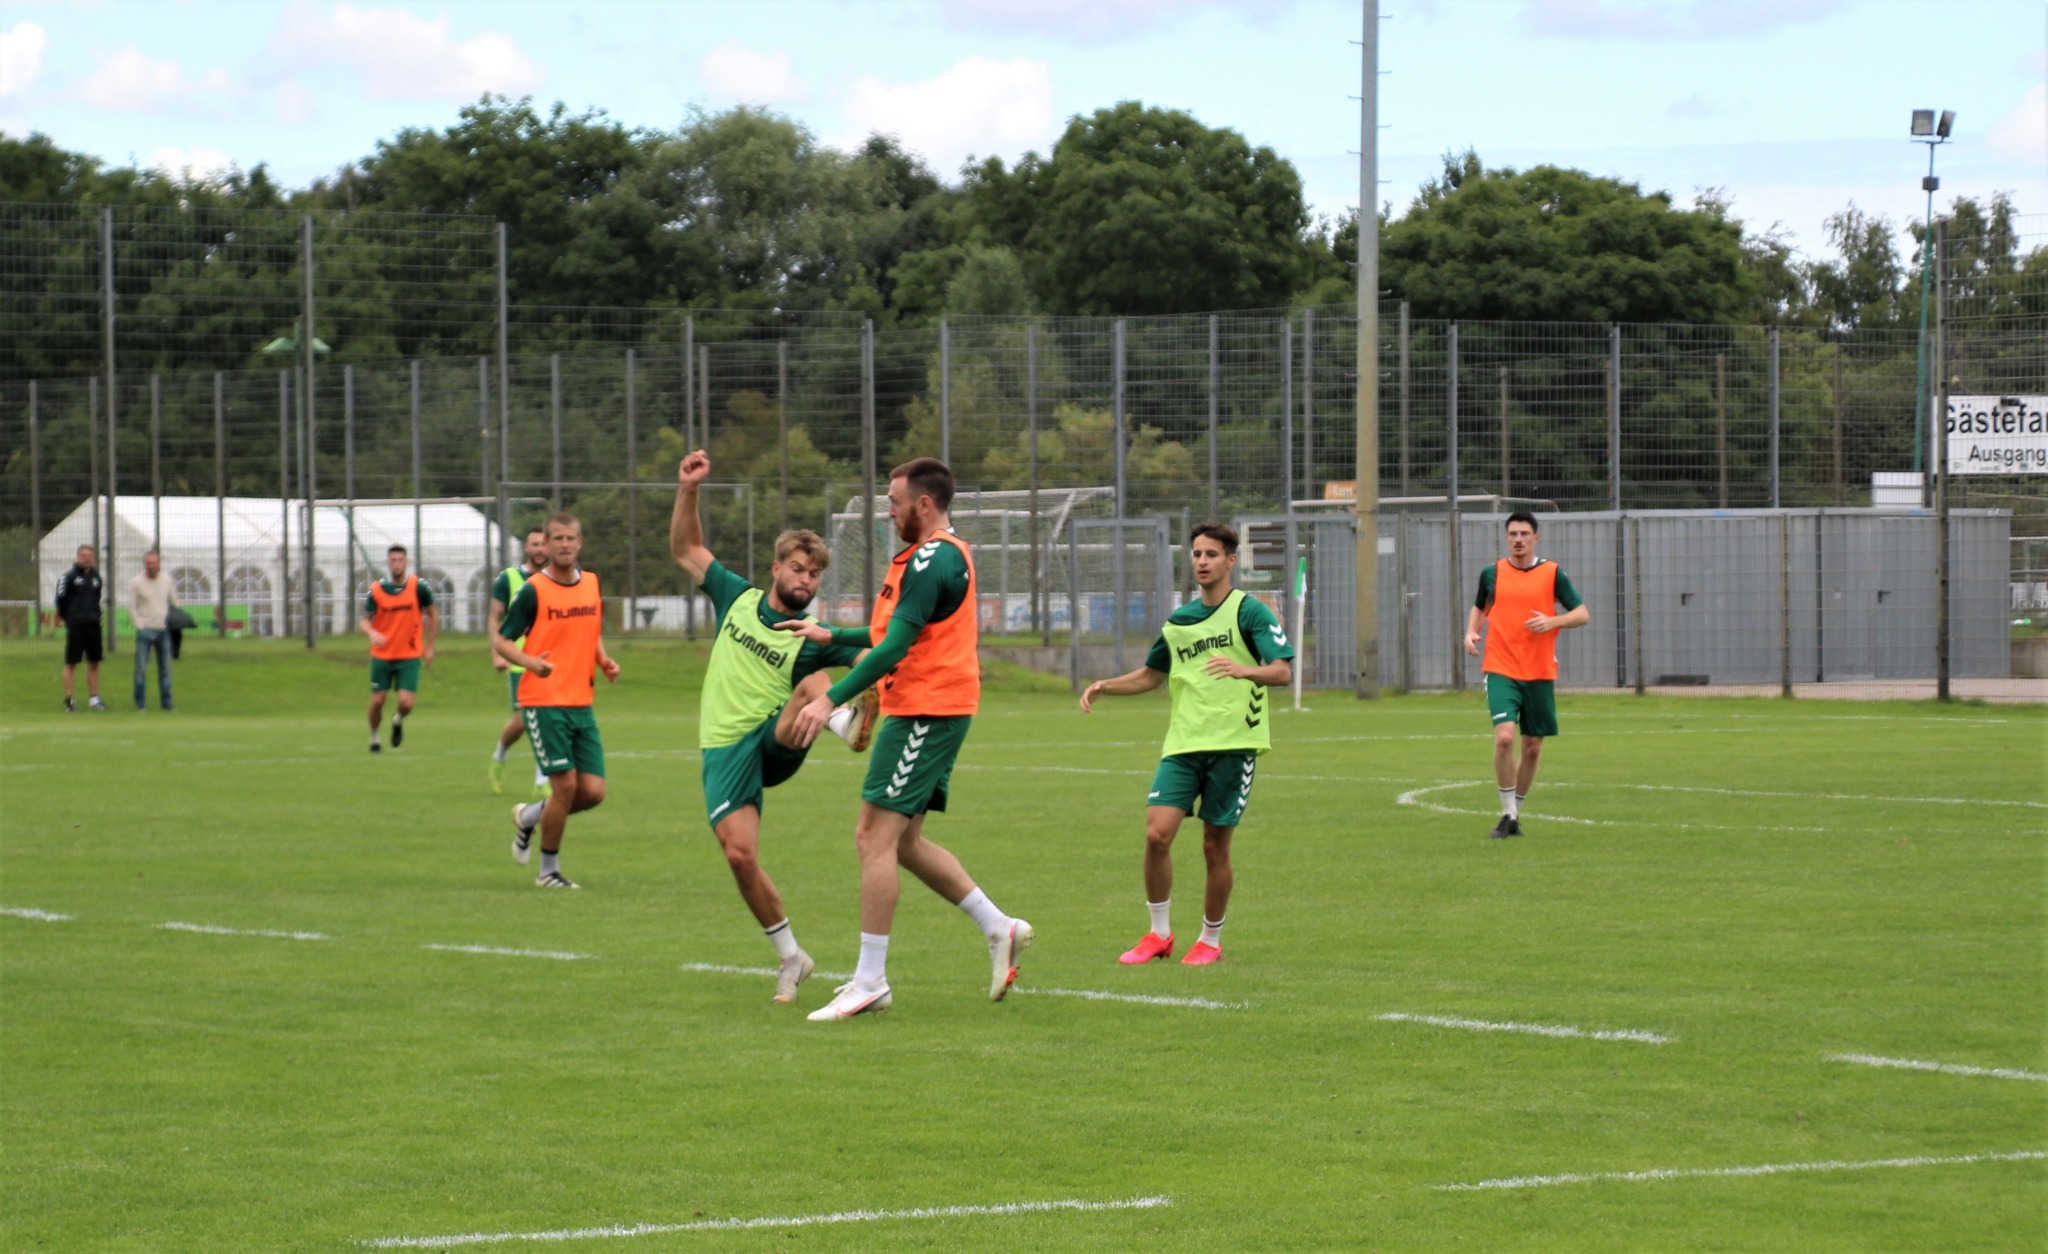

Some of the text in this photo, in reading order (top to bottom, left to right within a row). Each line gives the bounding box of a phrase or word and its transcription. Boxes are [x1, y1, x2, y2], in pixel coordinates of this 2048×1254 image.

[1946, 402, 2048, 434] Gästefa
[1968, 444, 2047, 467] Ausgang
[547, 605, 598, 620] humme
[722, 615, 790, 670] hummel
[1176, 627, 1234, 663] hummel
